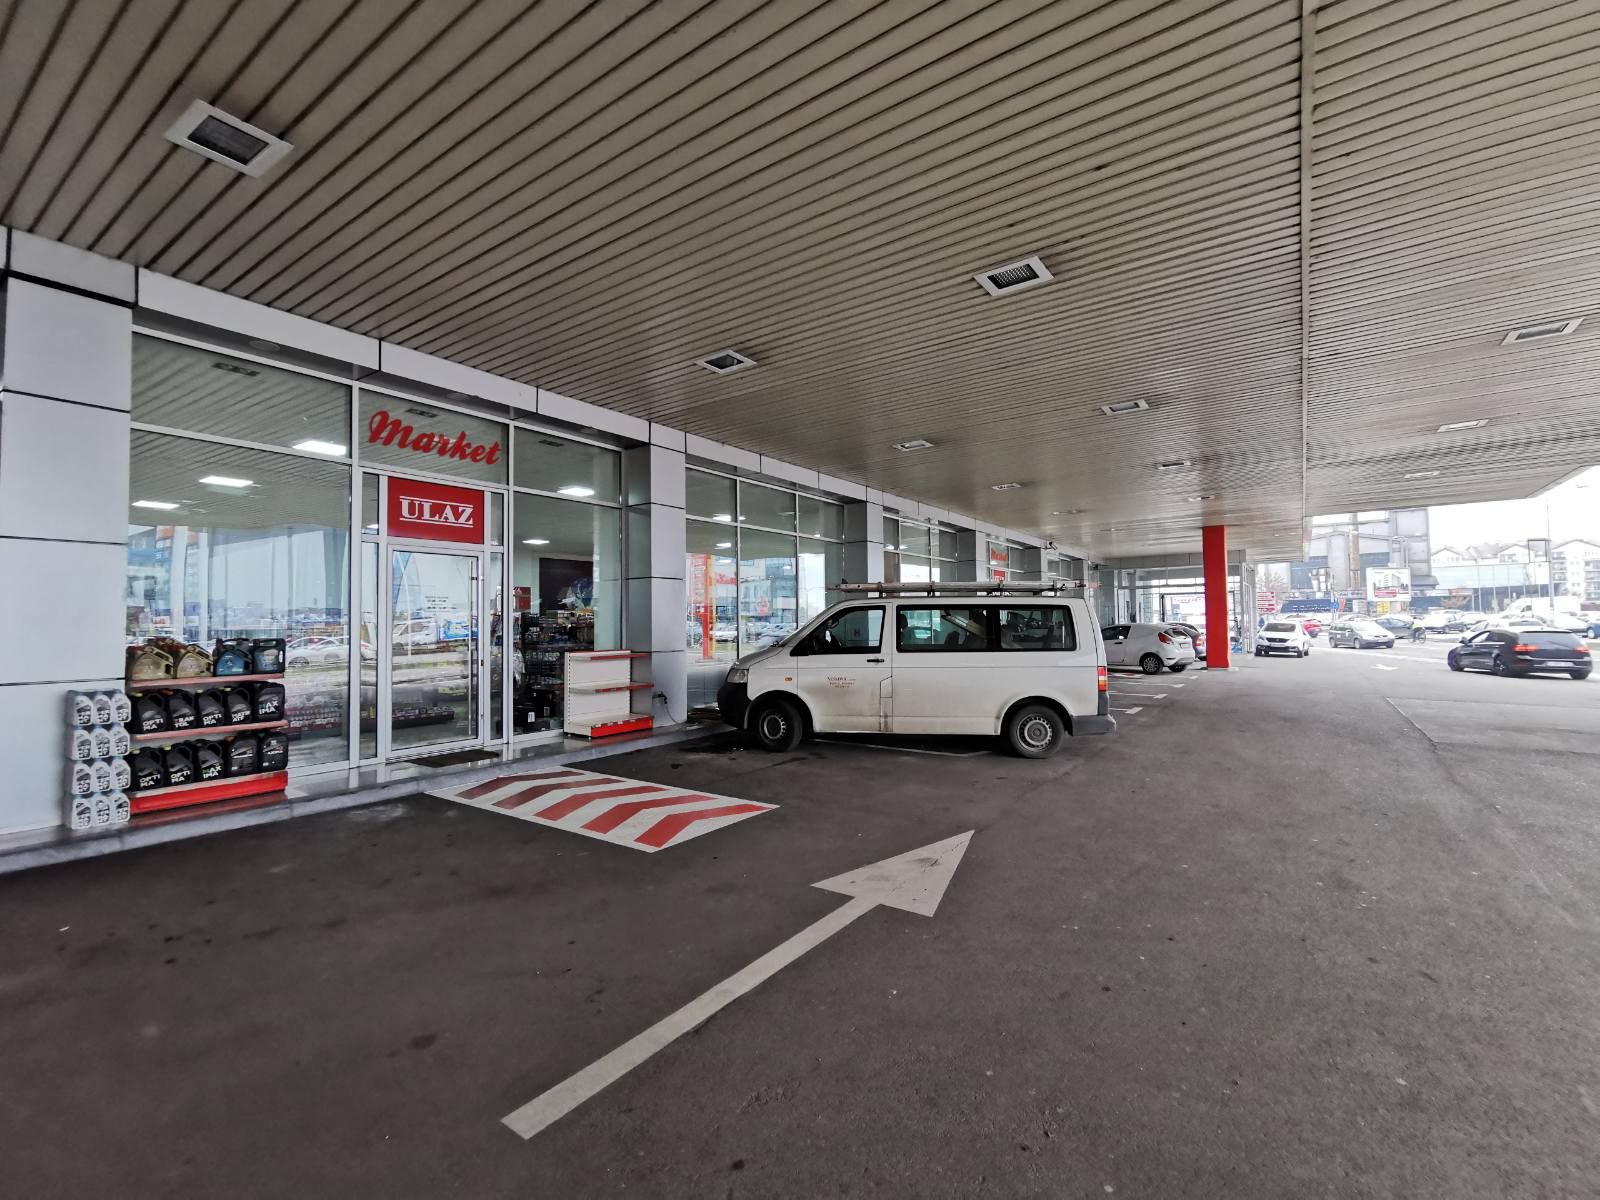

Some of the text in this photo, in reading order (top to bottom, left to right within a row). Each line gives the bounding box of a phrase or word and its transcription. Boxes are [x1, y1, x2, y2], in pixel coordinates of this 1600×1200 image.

[368, 410, 503, 465] Market
[399, 499, 474, 525] ULAZ
[142, 718, 164, 727] OPTI
[139, 774, 161, 783] OPTI
[170, 770, 191, 779] OPTI
